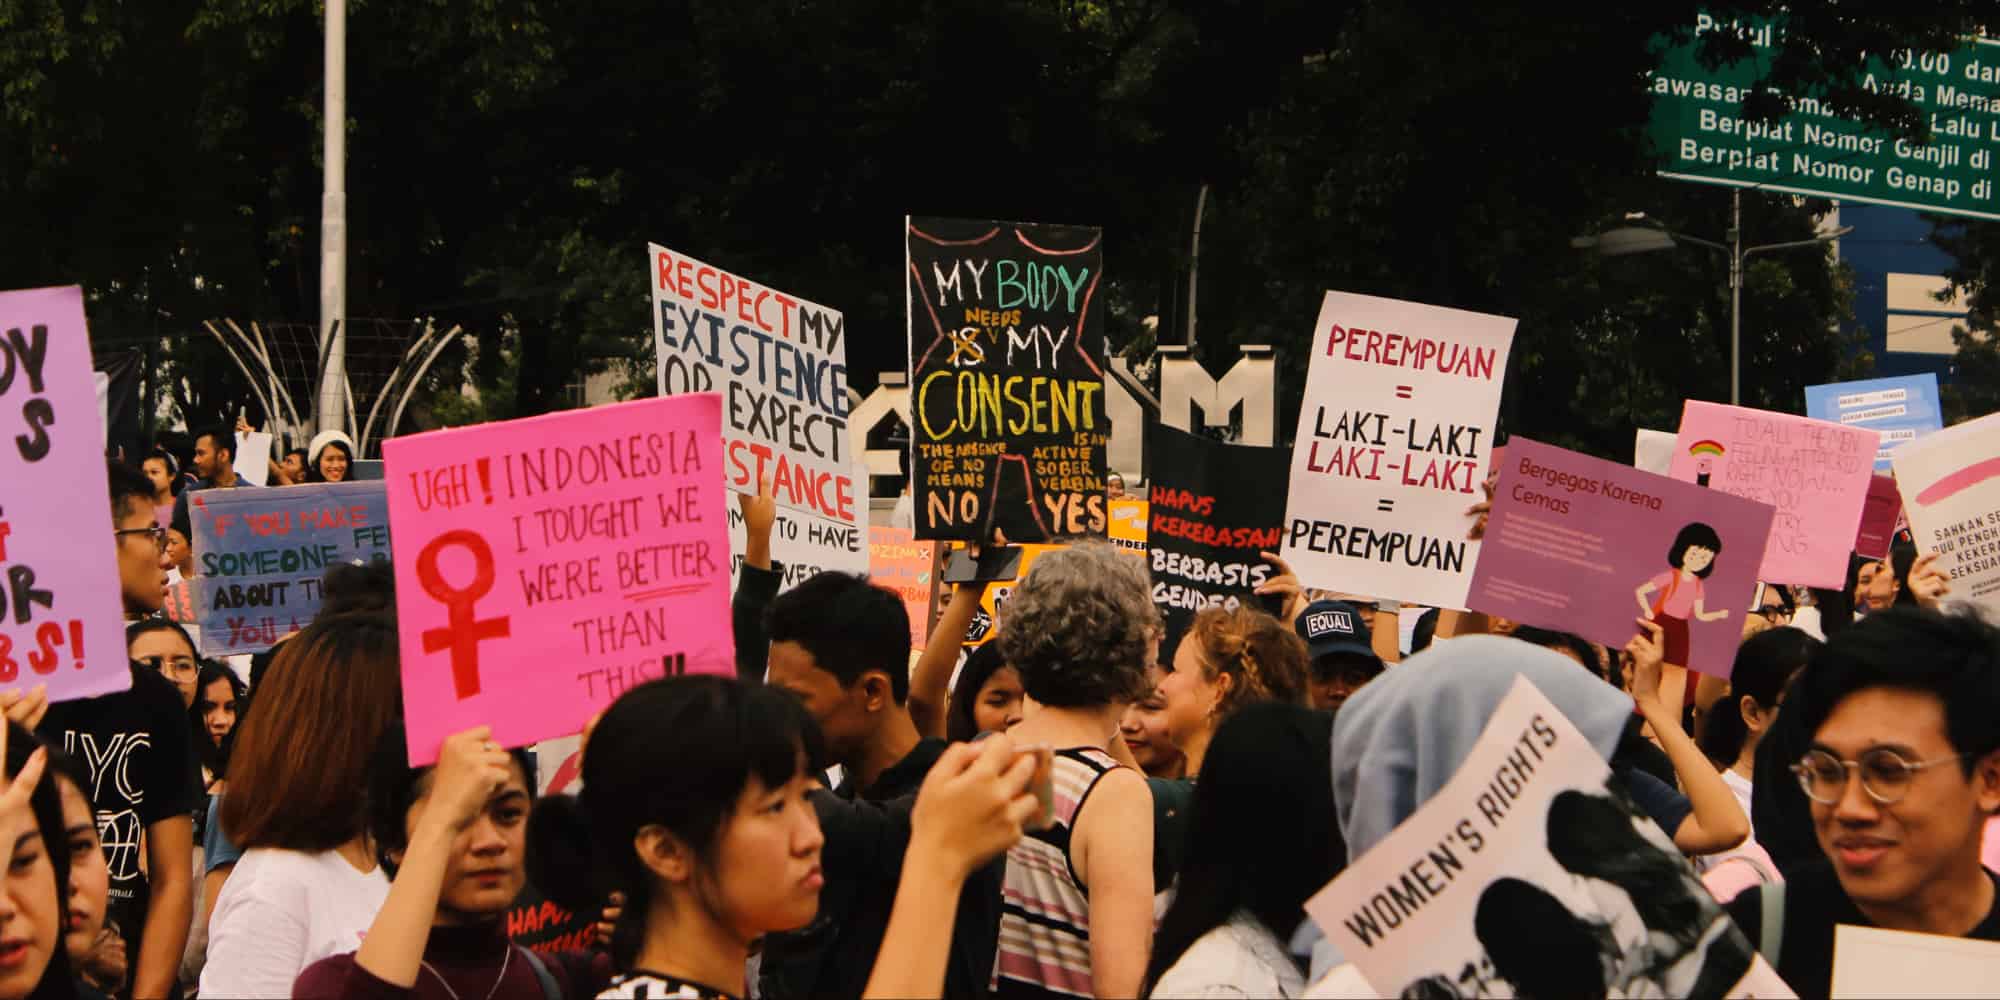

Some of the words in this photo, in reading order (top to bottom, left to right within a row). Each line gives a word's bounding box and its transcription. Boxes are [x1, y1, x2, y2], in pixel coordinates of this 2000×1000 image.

[1645, 70, 1752, 104] awasa
[1930, 113, 1980, 138] Lalu
[1804, 122, 1884, 155] Nomor
[1894, 139, 1960, 169] Ganjil
[1970, 148, 1991, 171] di
[1793, 152, 1874, 184] Nomor
[1886, 167, 1960, 199] Genap
[1971, 178, 1992, 200] di
[657, 251, 797, 339] RESPECT
[799, 304, 842, 356] MY
[932, 258, 990, 307] MY
[997, 259, 1089, 313] BODY
[965, 307, 1022, 327] NEEDS
[661, 299, 849, 420] EXISTENCE
[1006, 324, 1070, 370] MY
[1326, 323, 1497, 380] PEREMPUAN
[729, 380, 847, 463] EXPECT
[919, 369, 1102, 440] CONSENT
[1033, 446, 1093, 460] ACTIVE
[1073, 432, 1089, 446] IS
[1314, 406, 1482, 459] LAKI-LAKI
[504, 430, 702, 500] INDONESIA
[927, 473, 985, 489] MEANS
[930, 459, 953, 473] OF
[962, 458, 985, 473] NO
[1036, 459, 1094, 477] SOBER
[1040, 474, 1106, 491] VERBAL
[1307, 440, 1478, 494] LAKI-LAKI
[1517, 457, 1598, 494] Bergegas
[1600, 479, 1663, 511] Karena
[243, 510, 291, 537] YOU
[300, 505, 369, 531] MAKE
[512, 515, 528, 553] I
[534, 496, 644, 548] TOUGHT
[658, 486, 702, 527] WE
[927, 489, 980, 529] NO
[1044, 491, 1107, 535] YES
[1150, 485, 1217, 516] HAPUS
[1511, 484, 1570, 514] Cemas
[201, 543, 339, 578] SOMEONE
[353, 525, 390, 548] FE
[776, 517, 798, 541] TO
[809, 522, 861, 552] HAVE
[1151, 513, 1281, 549] KEKERASAN
[1289, 518, 1466, 573] PEREMPUAN
[1934, 515, 1984, 541] SAHKAN
[518, 558, 603, 607] WERE
[616, 541, 718, 590] BETTER
[1150, 547, 1272, 588] BERBASIS
[0, 564, 54, 625] R
[213, 581, 290, 611] ABOUT
[572, 607, 666, 655] THAN
[1310, 614, 1350, 633] EQUAL
[65, 730, 150, 804] YC
[1344, 820, 1484, 949] WOMEN'S
[1477, 715, 1558, 828] RIGHTS
